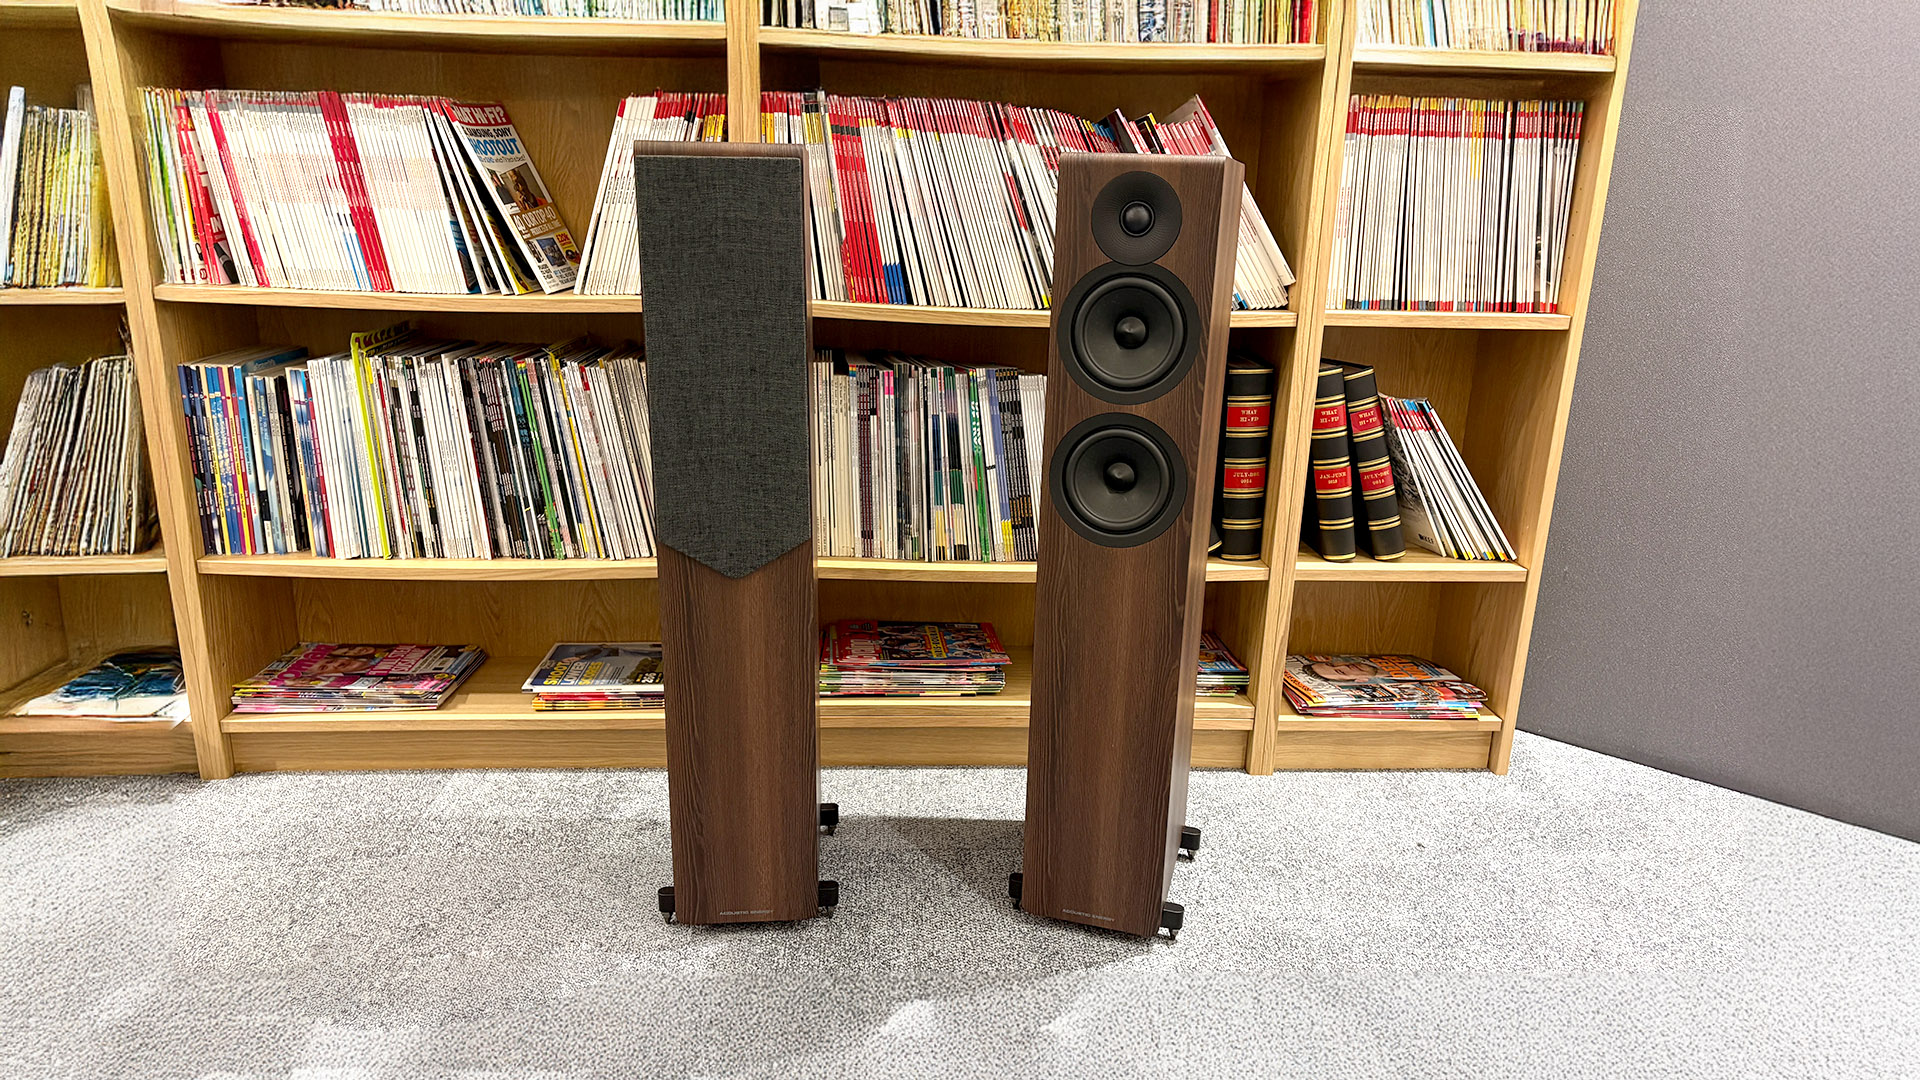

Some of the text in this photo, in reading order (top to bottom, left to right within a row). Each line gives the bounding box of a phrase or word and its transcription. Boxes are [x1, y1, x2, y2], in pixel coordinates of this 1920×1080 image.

[1358, 410, 1375, 419] WHAT
[543, 661, 570, 686] SHOOT
[560, 661, 587, 686] LOWER
[578, 661, 604, 686] SCORES
[1369, 657, 1410, 678] DEEP
[1062, 908, 1091, 918] ACOUSTIC
